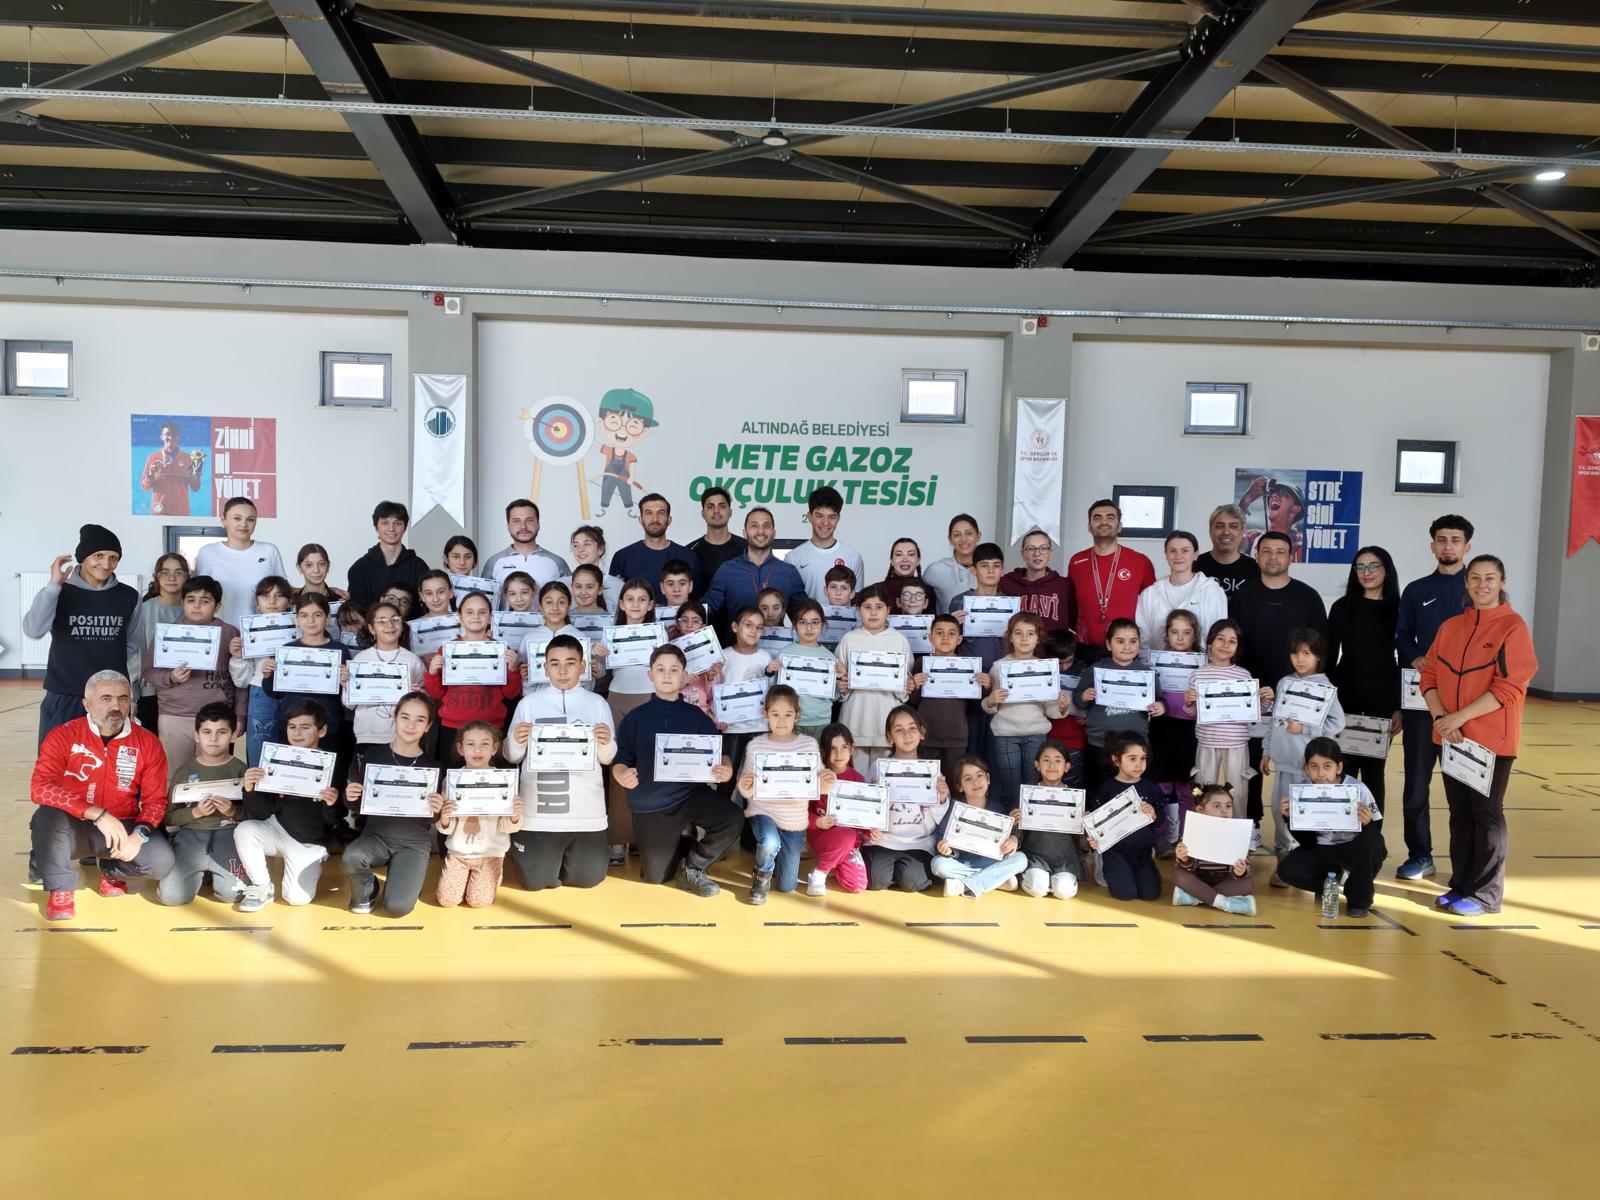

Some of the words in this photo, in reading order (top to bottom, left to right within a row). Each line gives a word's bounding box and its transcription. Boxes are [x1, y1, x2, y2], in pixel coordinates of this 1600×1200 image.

[214, 426, 255, 450] ZİHNİ
[741, 420, 809, 435] ALTINDAĞ
[812, 422, 890, 437] BELEDİYESİ
[214, 451, 231, 475] Nİ
[714, 443, 801, 470] METE
[805, 445, 913, 473] GAZOZ
[214, 475, 262, 500] YÖNET
[842, 475, 939, 506] TESİSİ
[1308, 481, 1343, 502] STRE
[1306, 503, 1335, 526] SİNİ
[1305, 525, 1348, 549] YÖNET
[69, 615, 123, 626] POSITIVE
[71, 626, 120, 636] ATTITUDE
